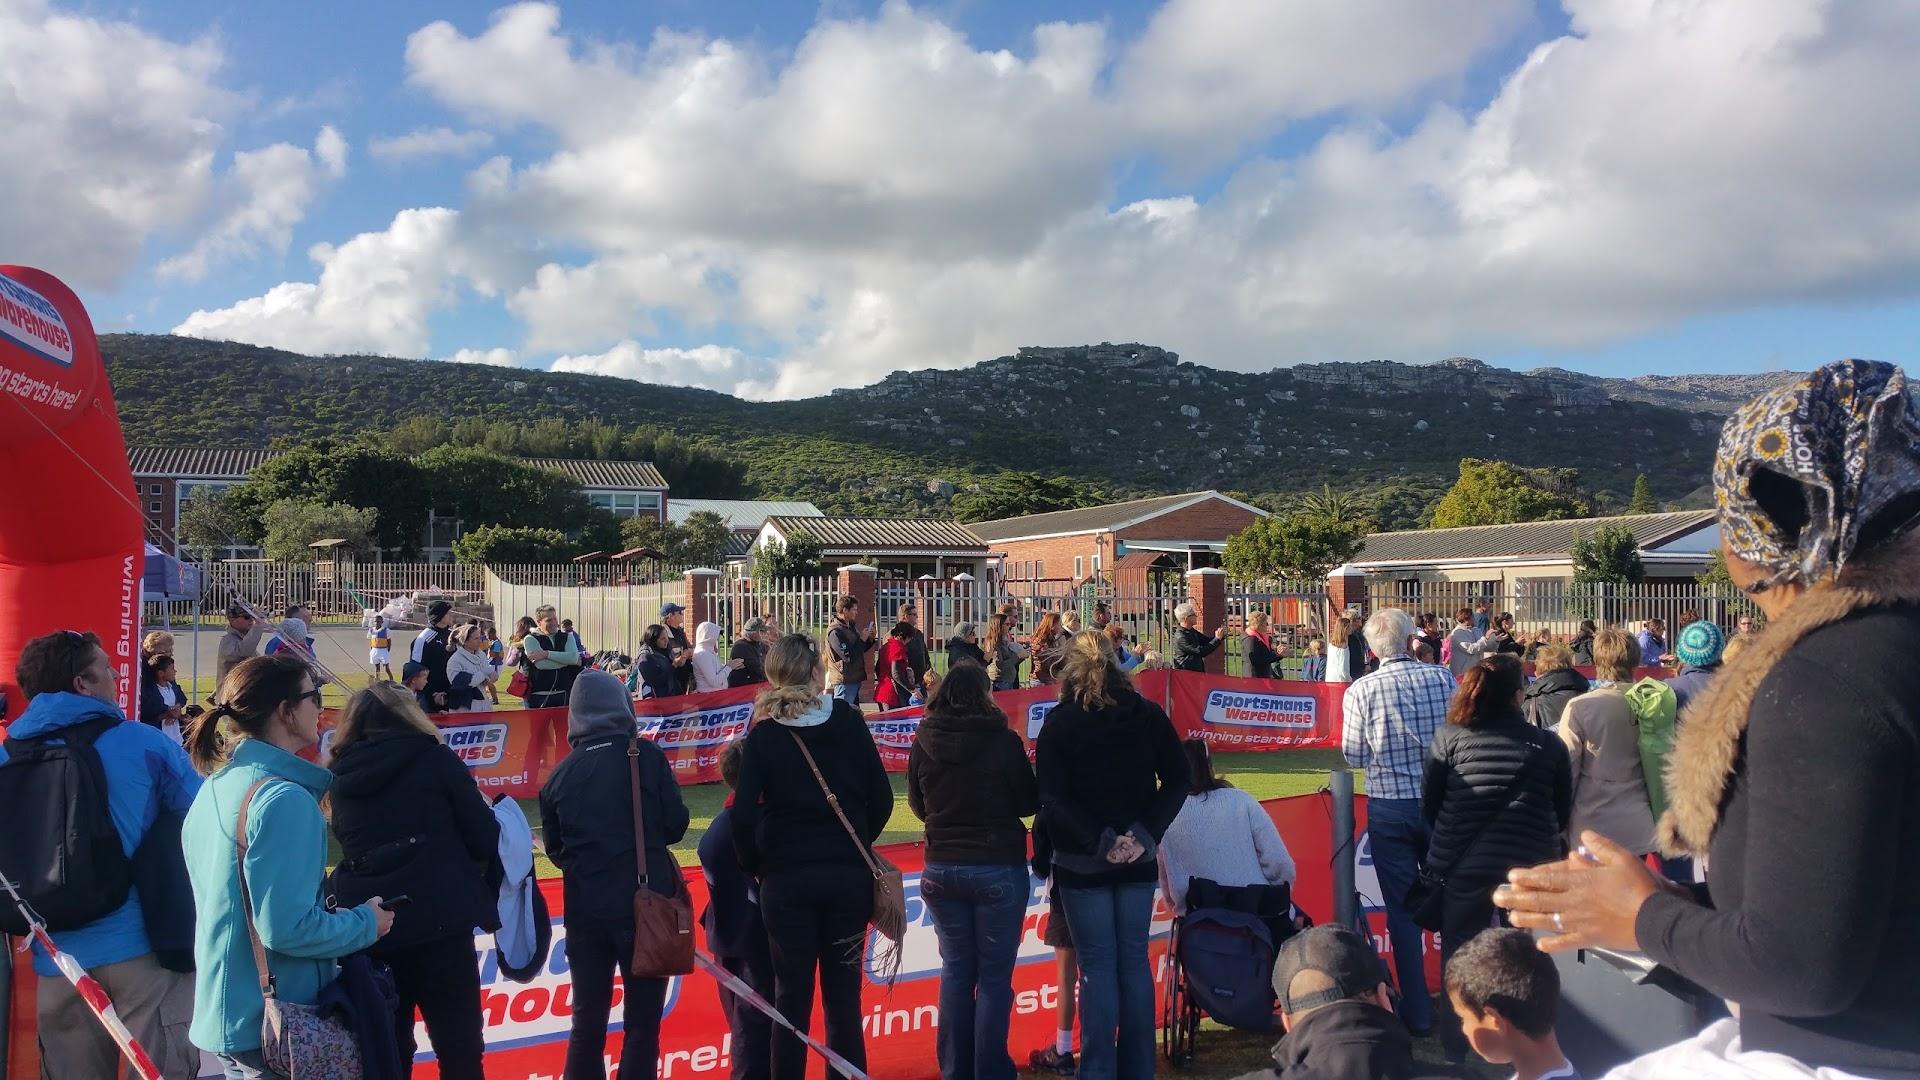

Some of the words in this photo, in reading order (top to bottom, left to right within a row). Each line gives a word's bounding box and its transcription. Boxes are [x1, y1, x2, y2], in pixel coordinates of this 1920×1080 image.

[6, 372, 51, 402] starts
[46, 381, 82, 410] here!
[116, 555, 134, 657] winning
[1210, 692, 1313, 712] Sportsmans
[1225, 707, 1312, 723] Warehouse
[1187, 728, 1243, 744] winning
[1244, 734, 1291, 745] starts
[1293, 735, 1328, 745] here!
